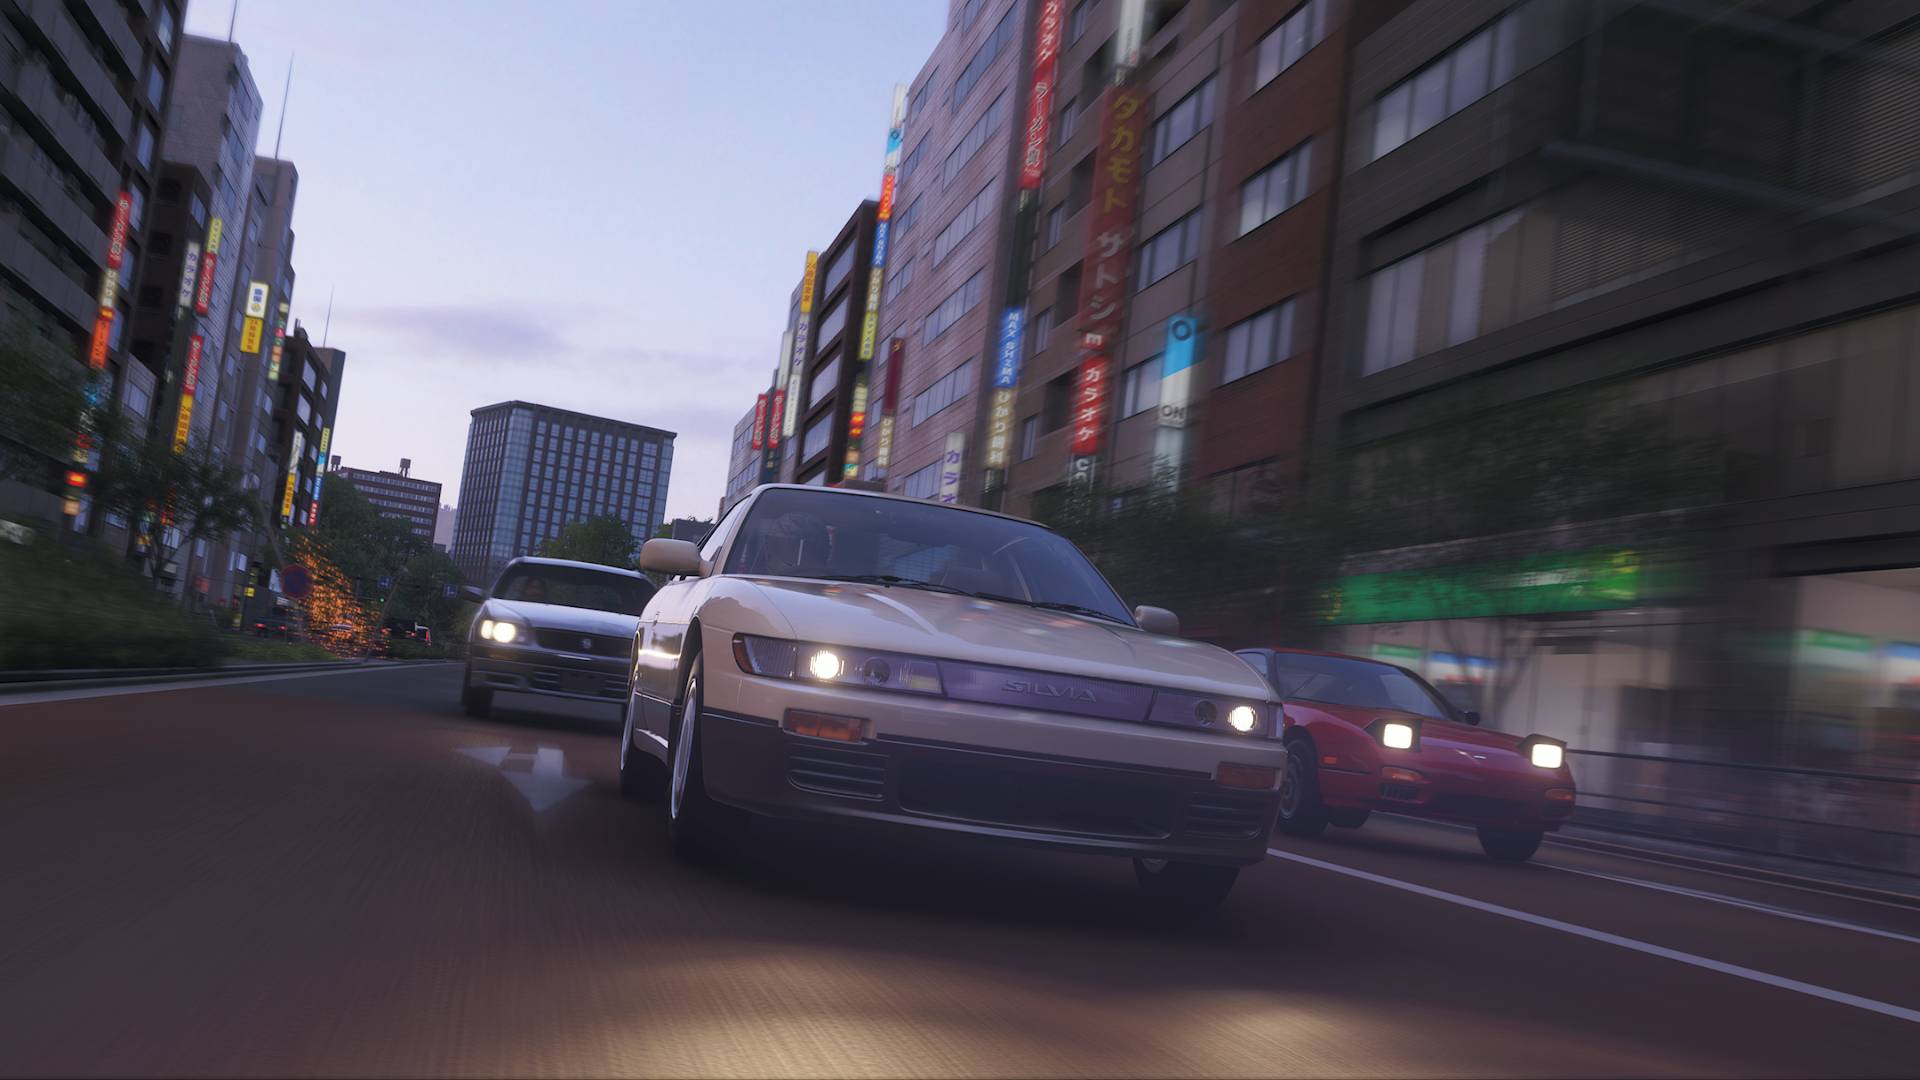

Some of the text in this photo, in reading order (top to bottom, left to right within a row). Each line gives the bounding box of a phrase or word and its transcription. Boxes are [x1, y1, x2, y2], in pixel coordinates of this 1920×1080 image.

[1104, 94, 1140, 214] タカモト
[1089, 231, 1125, 321] サトシ
[1001, 311, 1020, 385] MAX SHIMA
[1078, 367, 1101, 442] カラオケ
[1002, 680, 1097, 704] SILVIA
